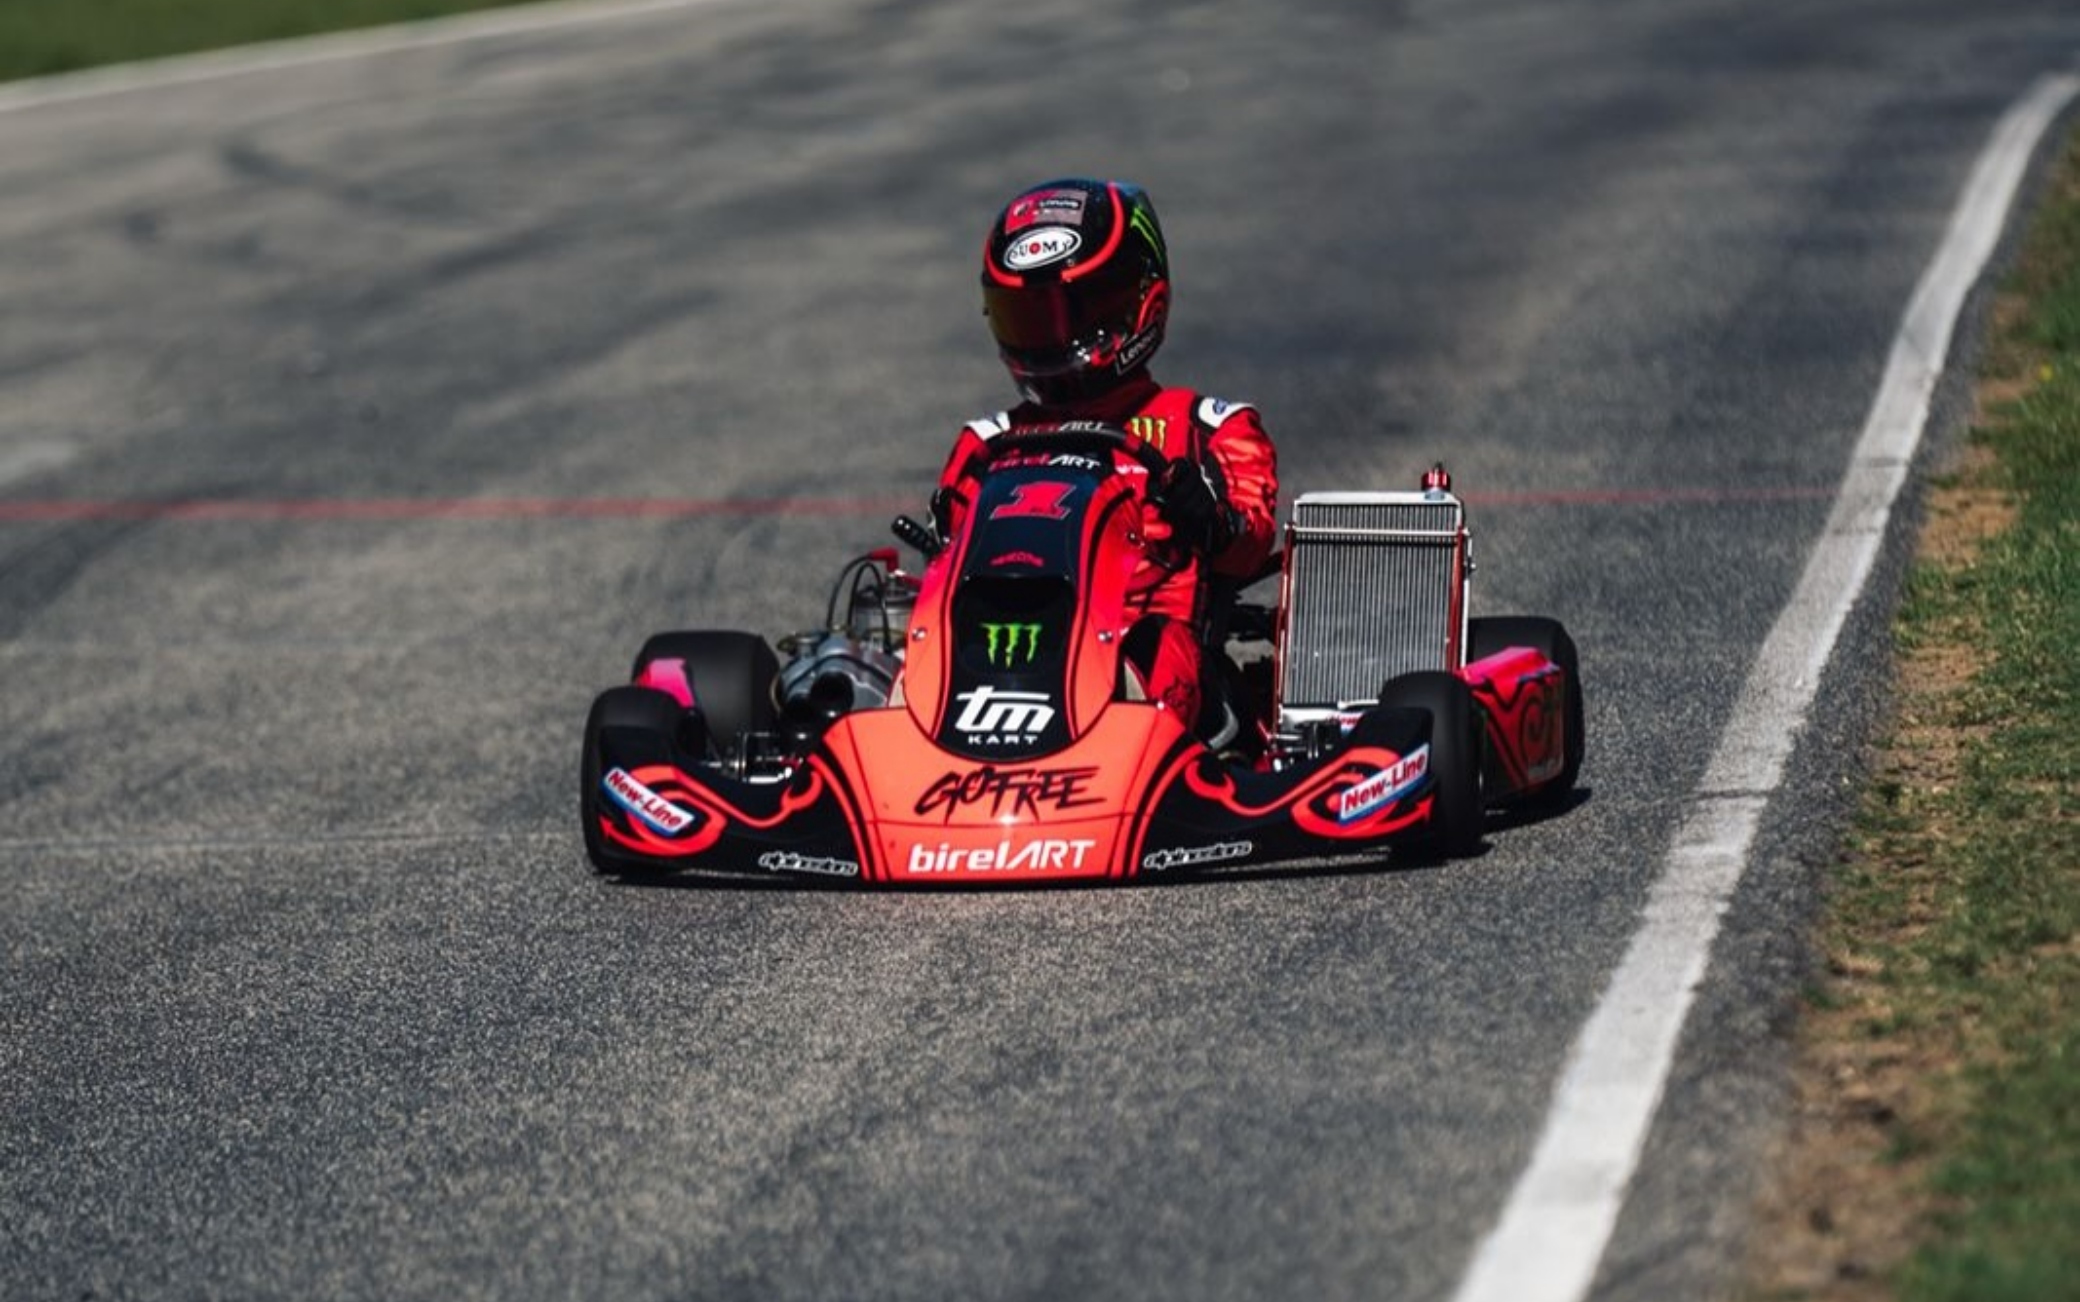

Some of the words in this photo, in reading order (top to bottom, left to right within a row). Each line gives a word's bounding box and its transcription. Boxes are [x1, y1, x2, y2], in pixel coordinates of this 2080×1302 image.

[1010, 239, 1072, 259] SUOMY
[990, 480, 1077, 520] 1
[955, 686, 1055, 732] tm
[968, 735, 1038, 745] KART
[607, 770, 683, 828] New-Line
[1343, 753, 1427, 812] New-Line
[908, 840, 1096, 872] birelART
